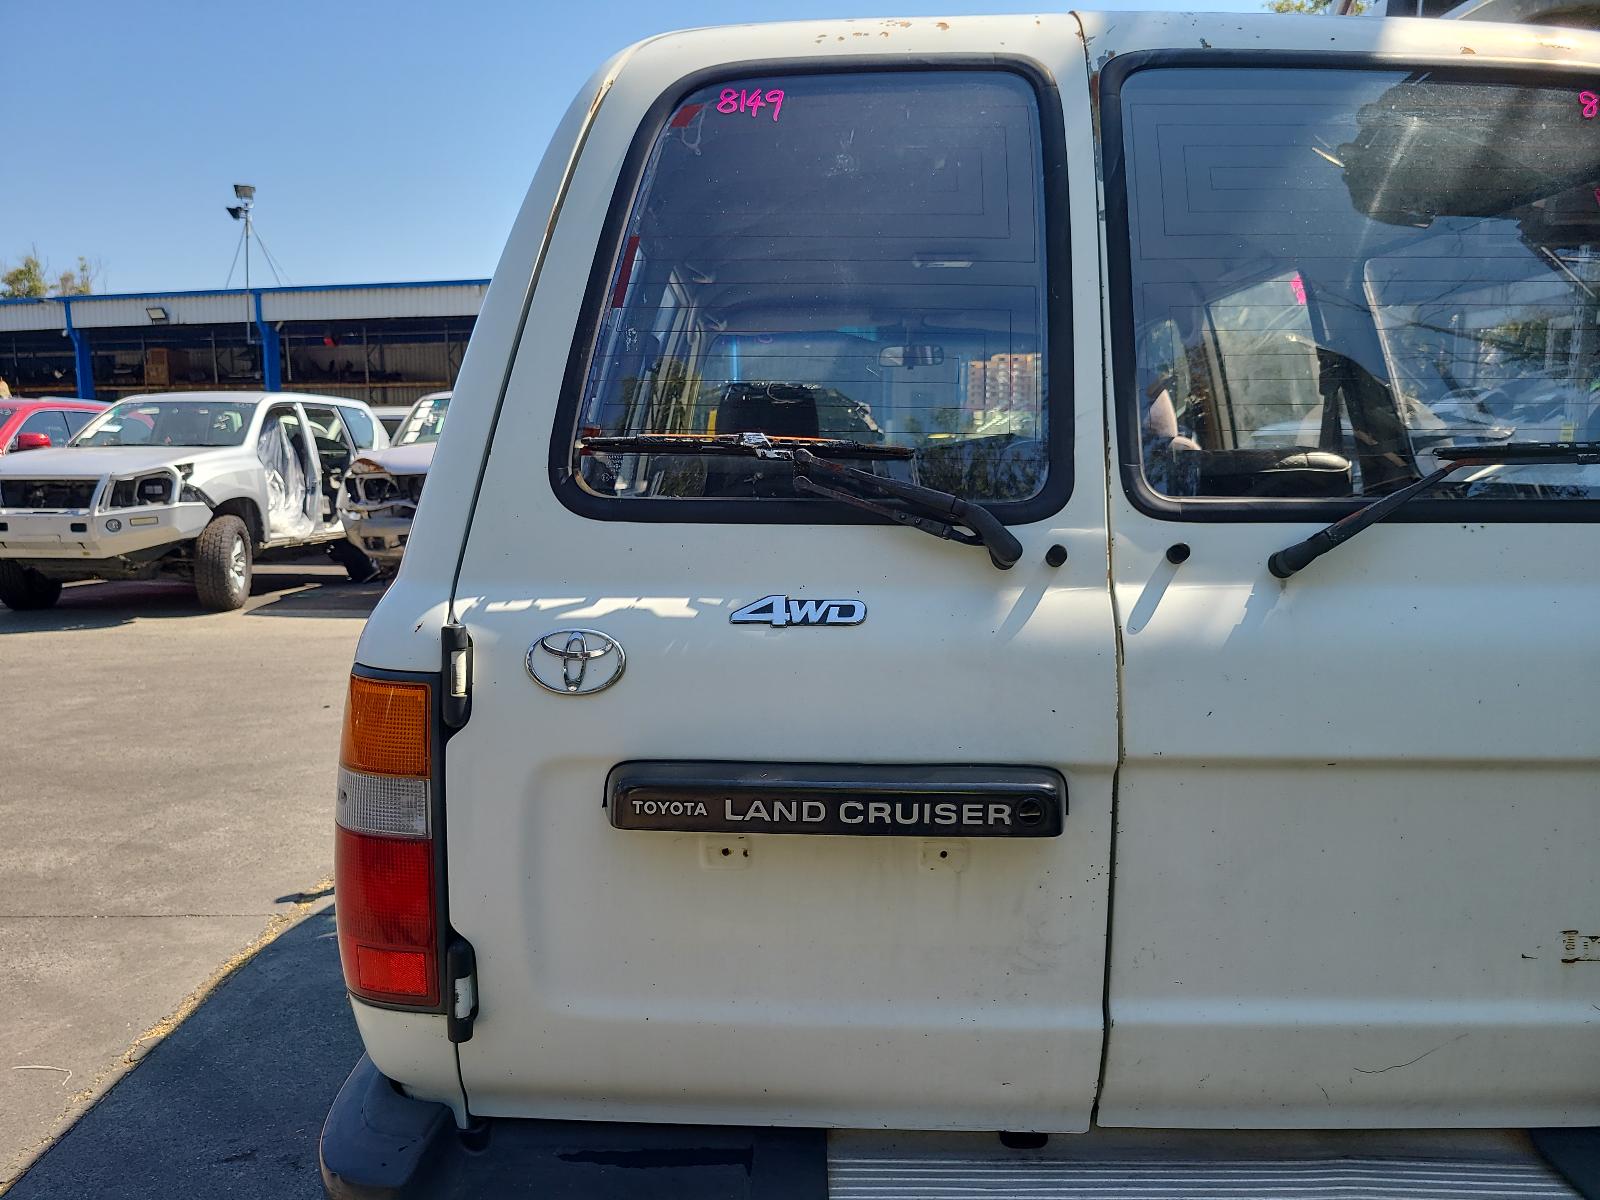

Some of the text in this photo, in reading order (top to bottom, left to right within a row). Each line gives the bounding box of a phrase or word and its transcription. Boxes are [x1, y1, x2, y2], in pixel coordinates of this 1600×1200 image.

[716, 88, 785, 122] 8149
[729, 594, 867, 628] 4WD
[631, 799, 1012, 826] TOYOTA LAND CRUISER
